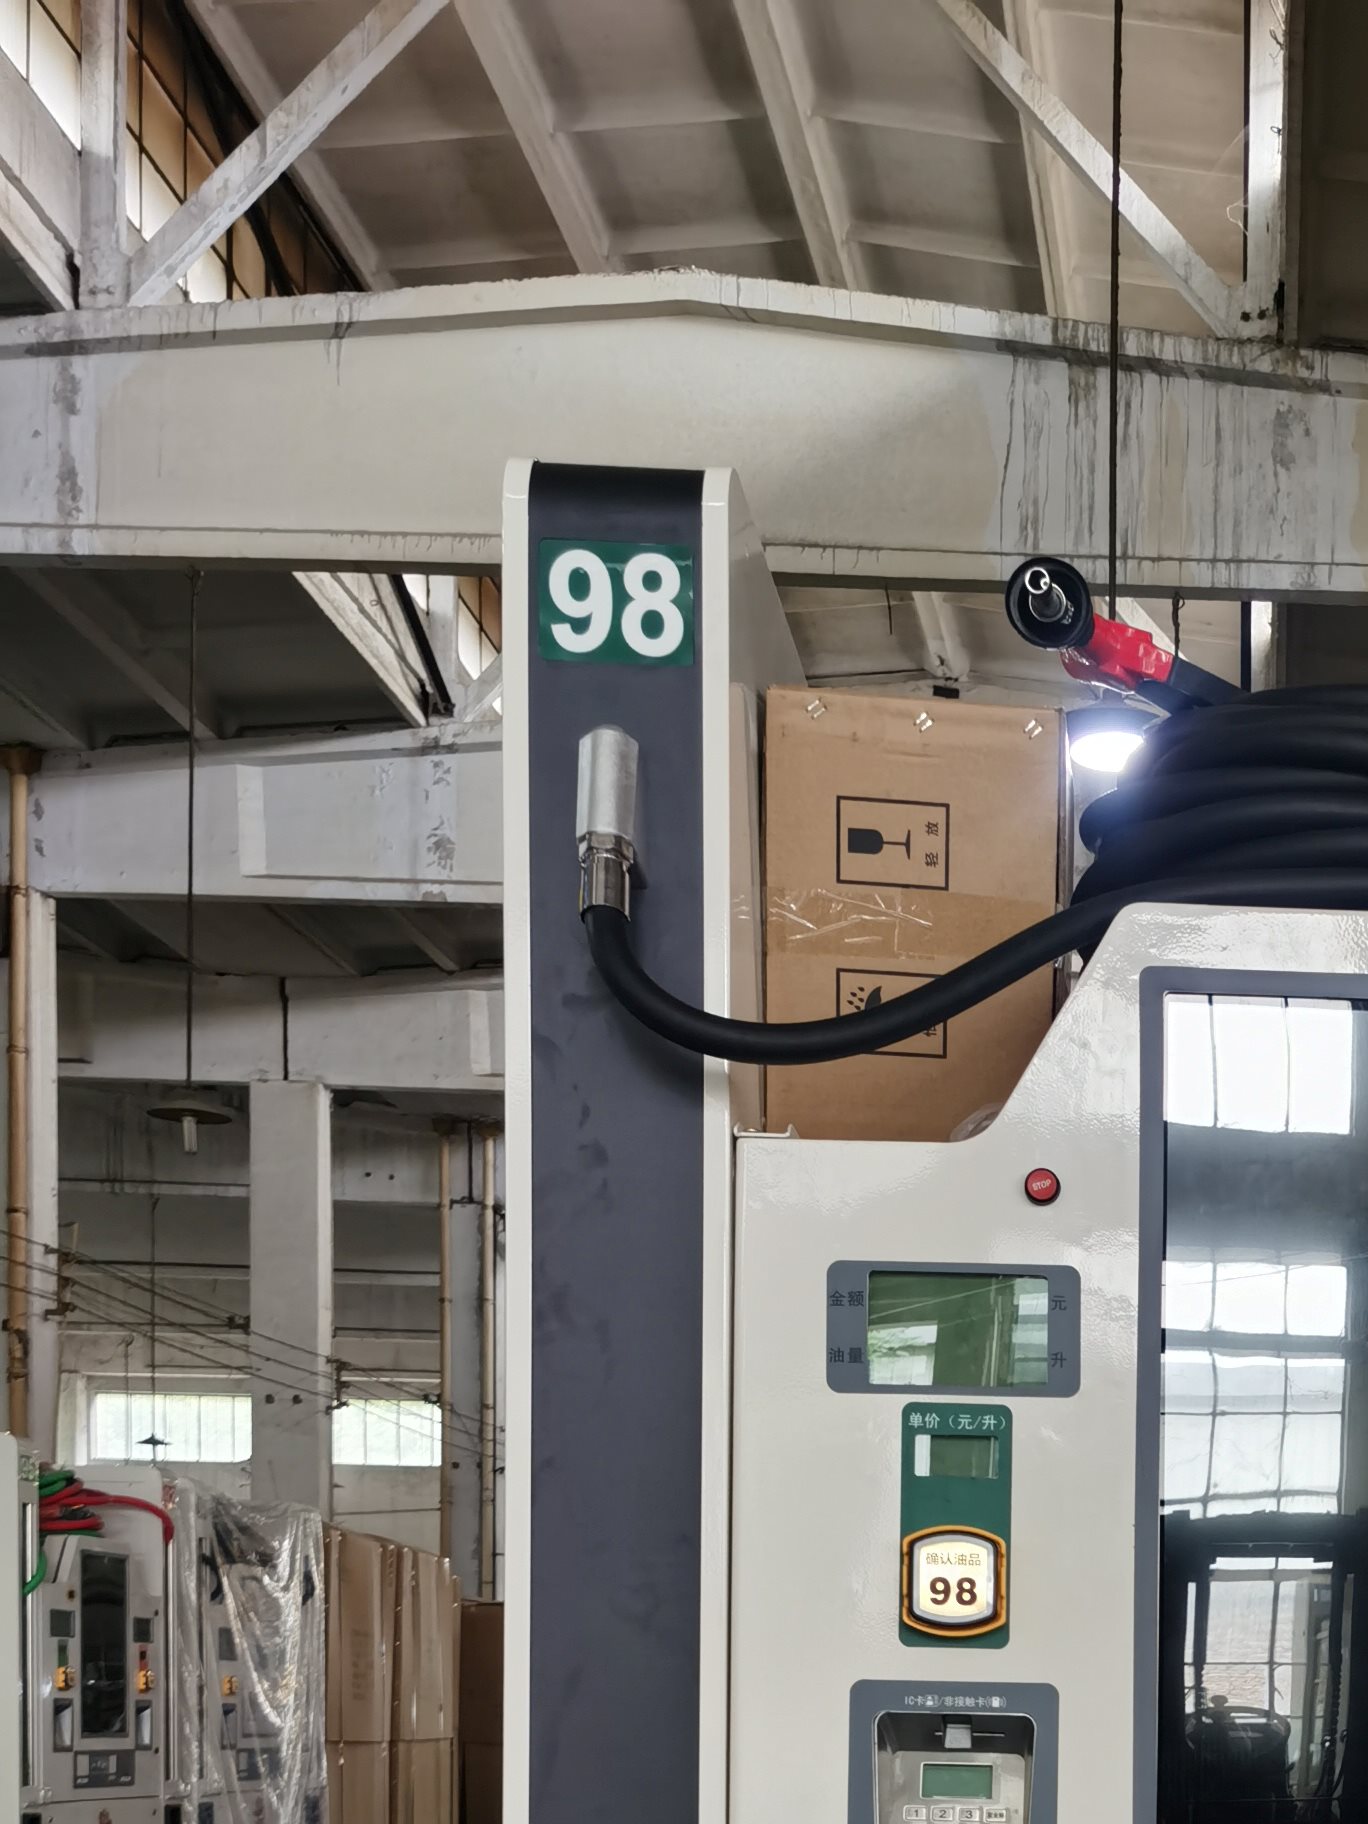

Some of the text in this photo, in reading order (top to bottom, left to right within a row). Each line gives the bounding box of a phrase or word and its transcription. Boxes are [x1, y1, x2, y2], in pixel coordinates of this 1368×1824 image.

[548, 549, 684, 657] 98
[924, 821, 939, 868] 轻放
[1032, 1179, 1052, 1191] STOP
[829, 1291, 865, 1306] 金额
[1052, 1296, 1067, 1311] 元
[829, 1348, 865, 1363] 油量
[1051, 1353, 1067, 1368] 升
[926, 1552, 981, 1566] 确认油品
[929, 1577, 978, 1605] 98
[939, 1810, 946, 1818] 2
[966, 1810, 973, 1818] 3
